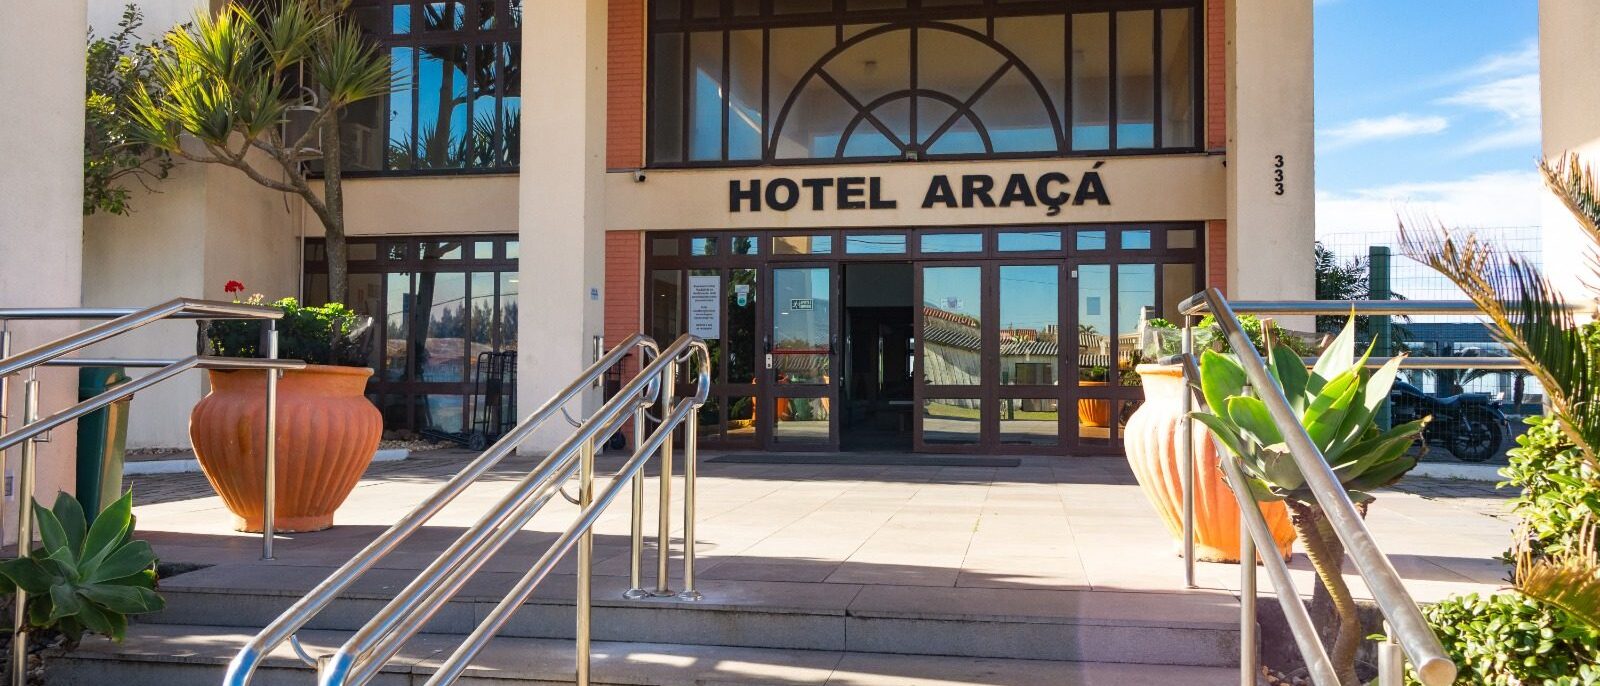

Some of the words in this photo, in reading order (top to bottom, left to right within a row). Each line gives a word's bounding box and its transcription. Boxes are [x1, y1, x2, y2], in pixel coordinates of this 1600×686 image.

[729, 177, 897, 213] HOTEL
[921, 161, 1111, 216] ARAÇÁ
[1274, 154, 1284, 196] 333
